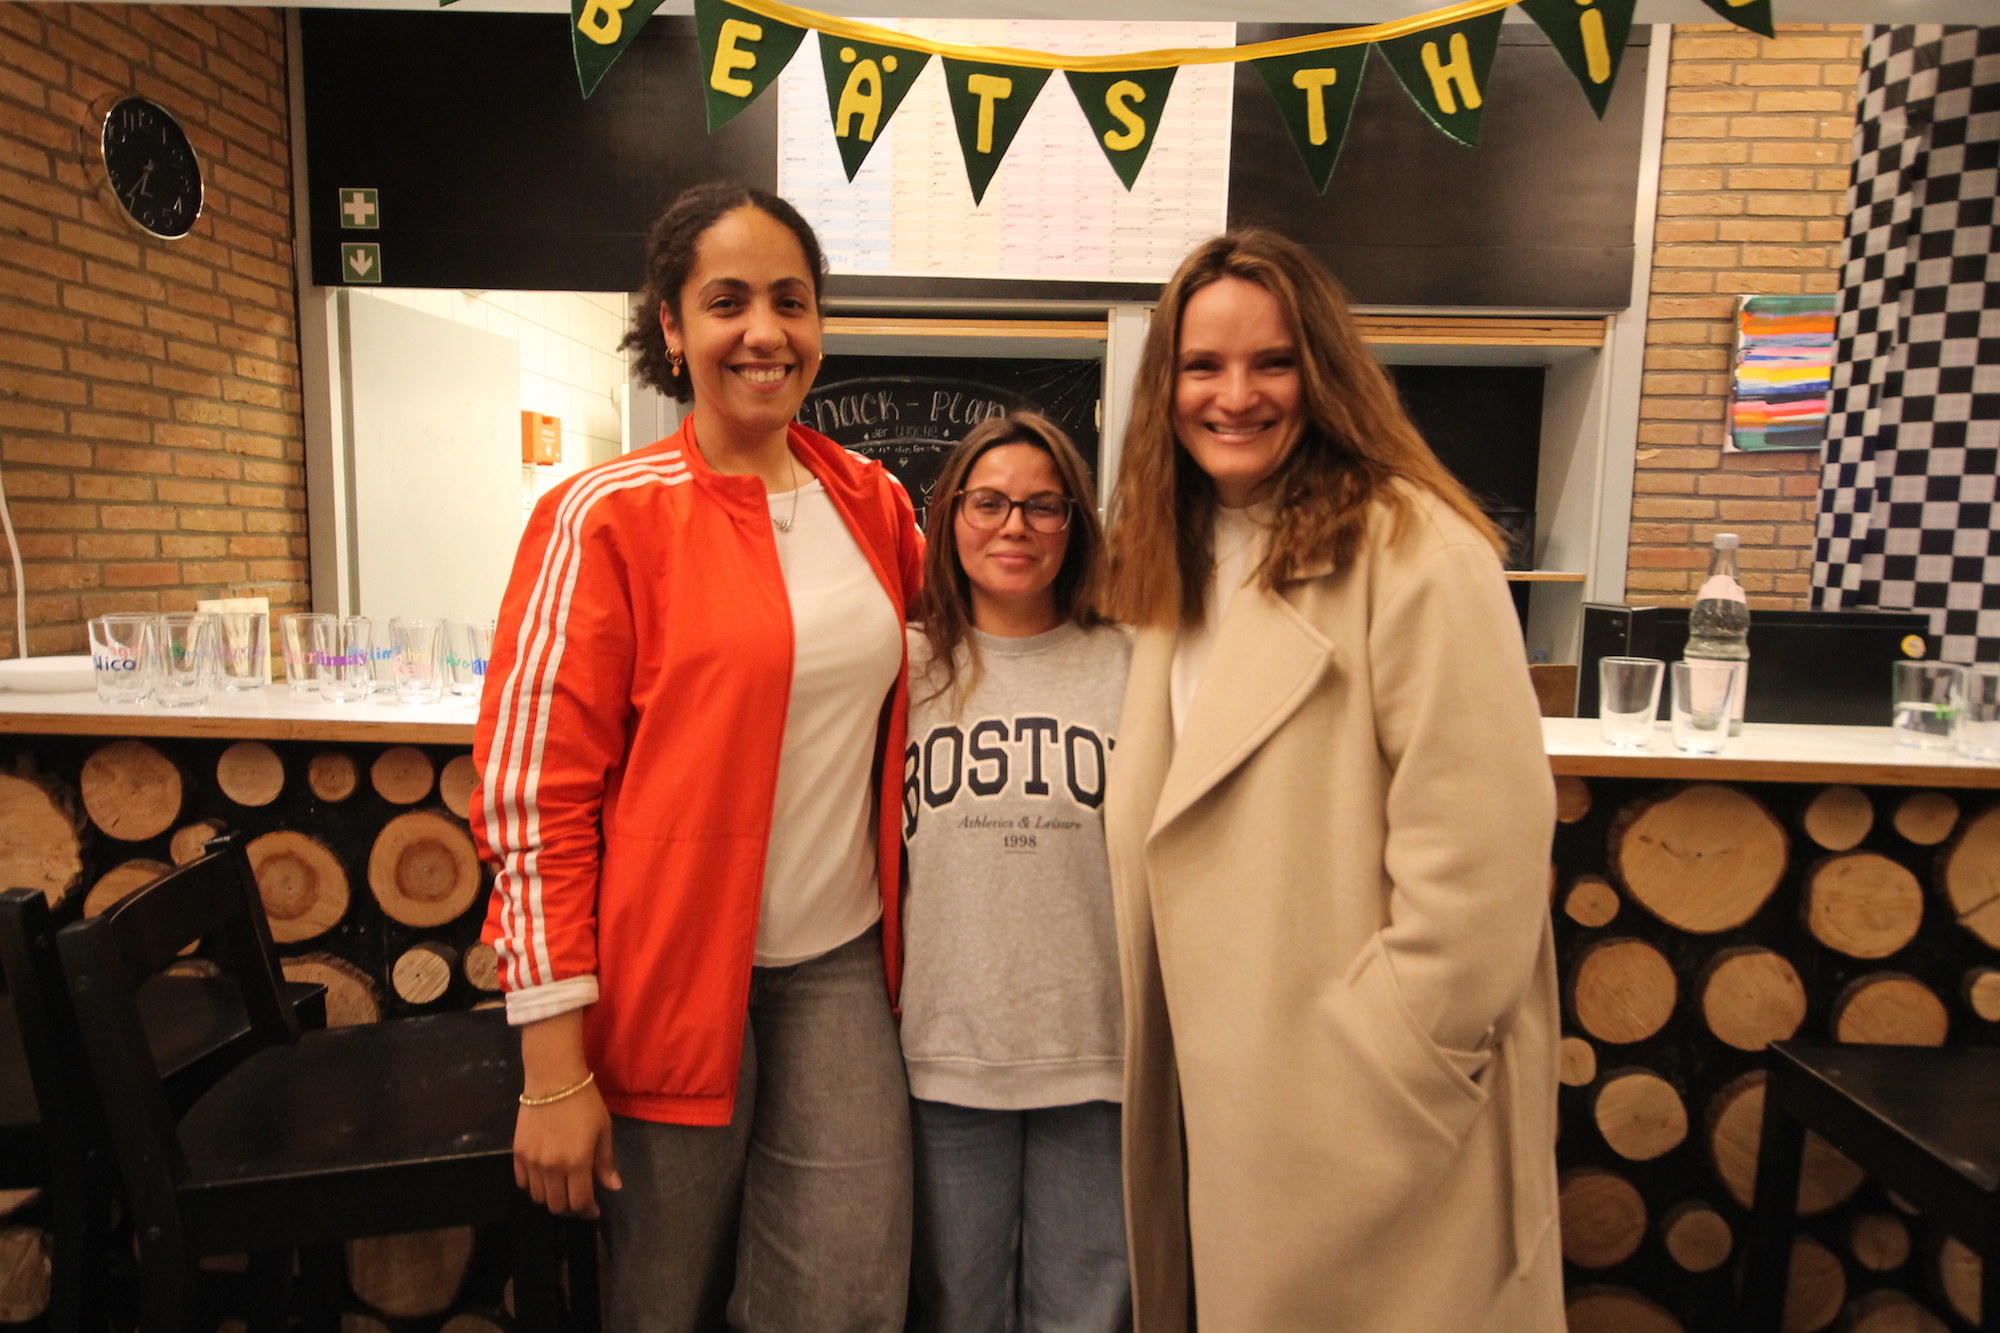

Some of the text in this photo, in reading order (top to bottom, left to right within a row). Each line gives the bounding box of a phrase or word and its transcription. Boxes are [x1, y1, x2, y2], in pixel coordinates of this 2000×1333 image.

[902, 717, 1116, 842] BOSTO
[957, 815, 1083, 831] Athletics & Leisure
[1004, 835, 1037, 848] 1998
